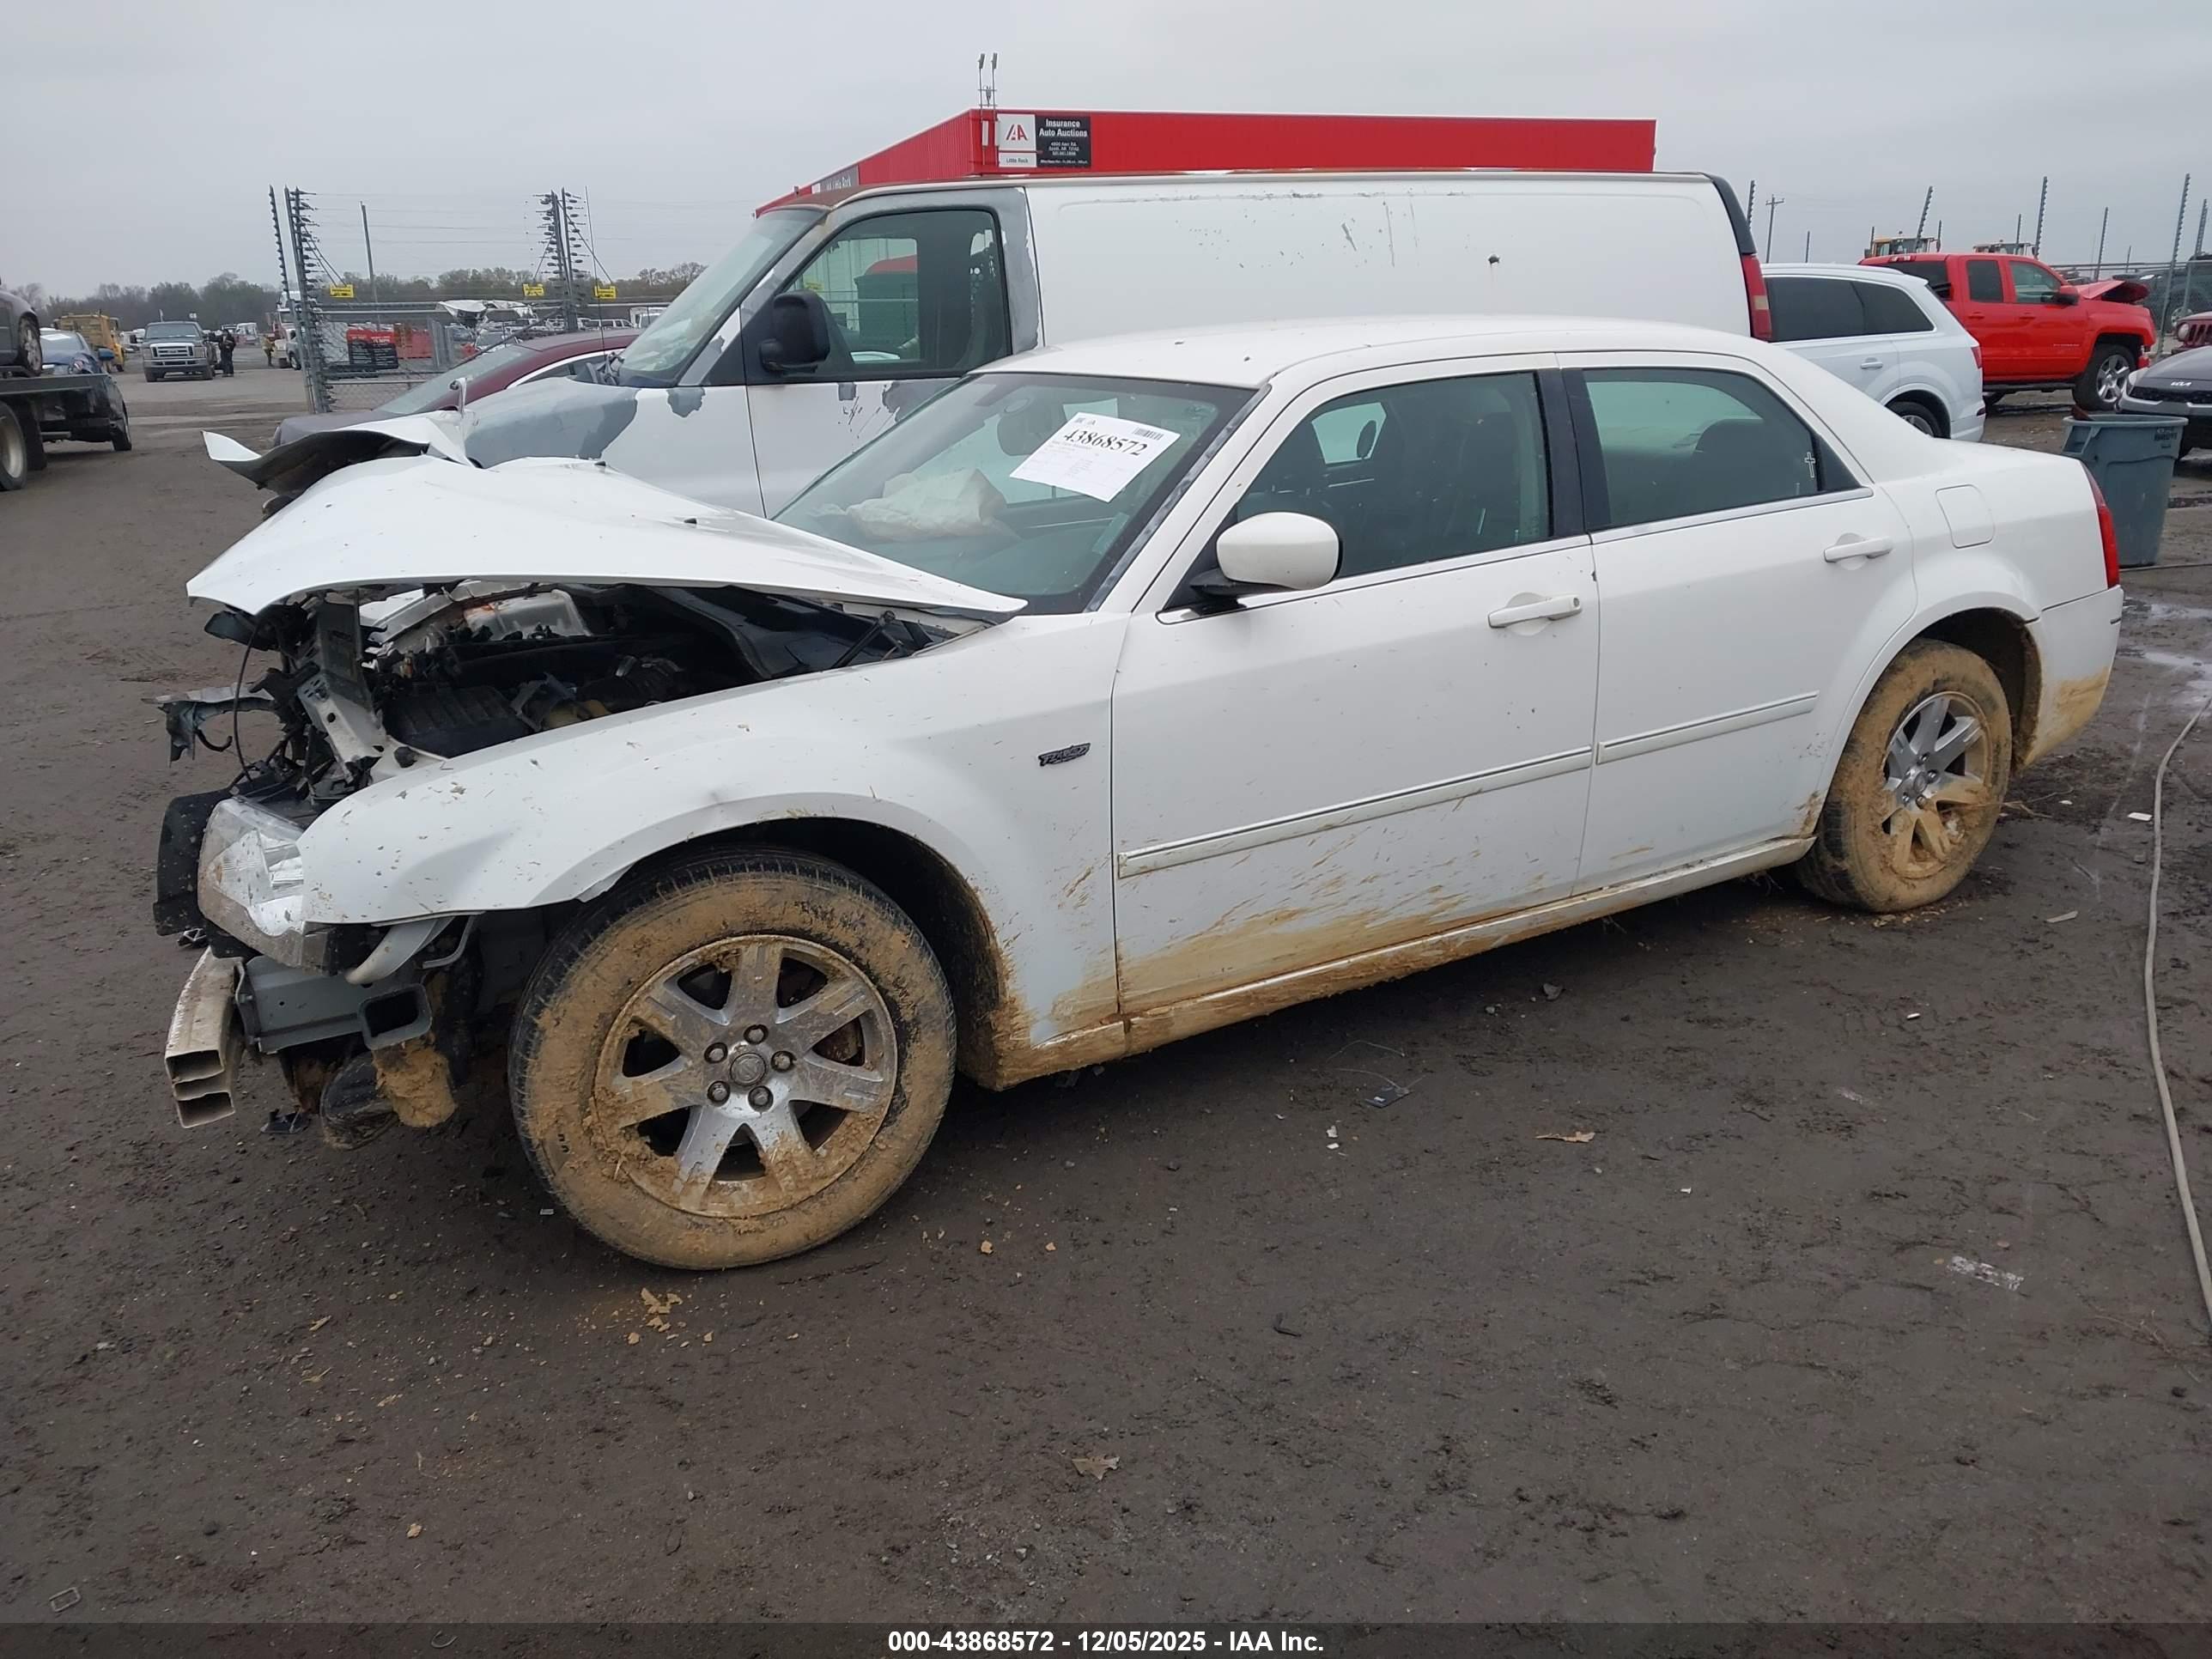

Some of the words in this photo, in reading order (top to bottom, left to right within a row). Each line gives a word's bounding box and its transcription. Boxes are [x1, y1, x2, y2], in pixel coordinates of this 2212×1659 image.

[1046, 118, 1081, 128] Insurance
[1039, 128, 1056, 137] Auto
[1057, 128, 1088, 137] Auctions
[1065, 428, 1147, 456] 43868572
